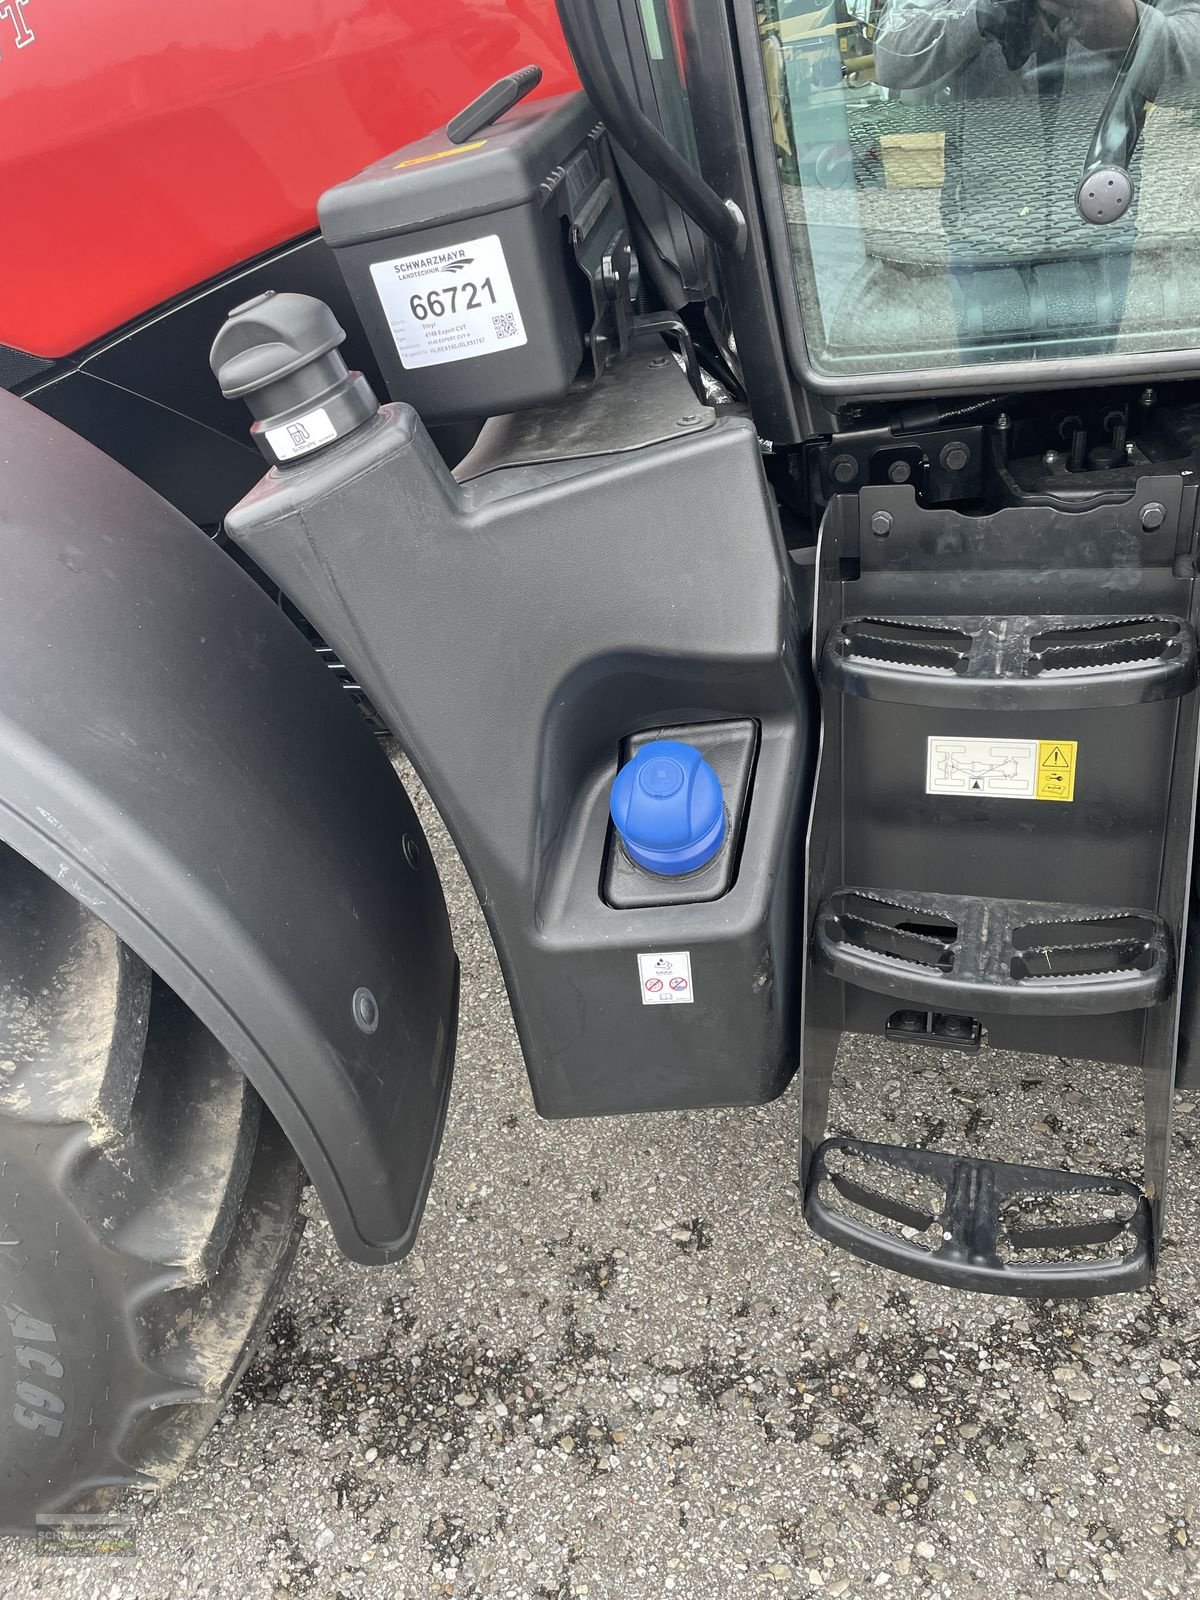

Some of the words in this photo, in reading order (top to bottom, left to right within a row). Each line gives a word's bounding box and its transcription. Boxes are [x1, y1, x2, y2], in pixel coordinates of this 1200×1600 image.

[394, 249, 466, 273] SCHWARZMAYR
[398, 267, 440, 281] LANDTECHNIK
[410, 277, 497, 321] 66721
[455, 324, 467, 332] CVT
